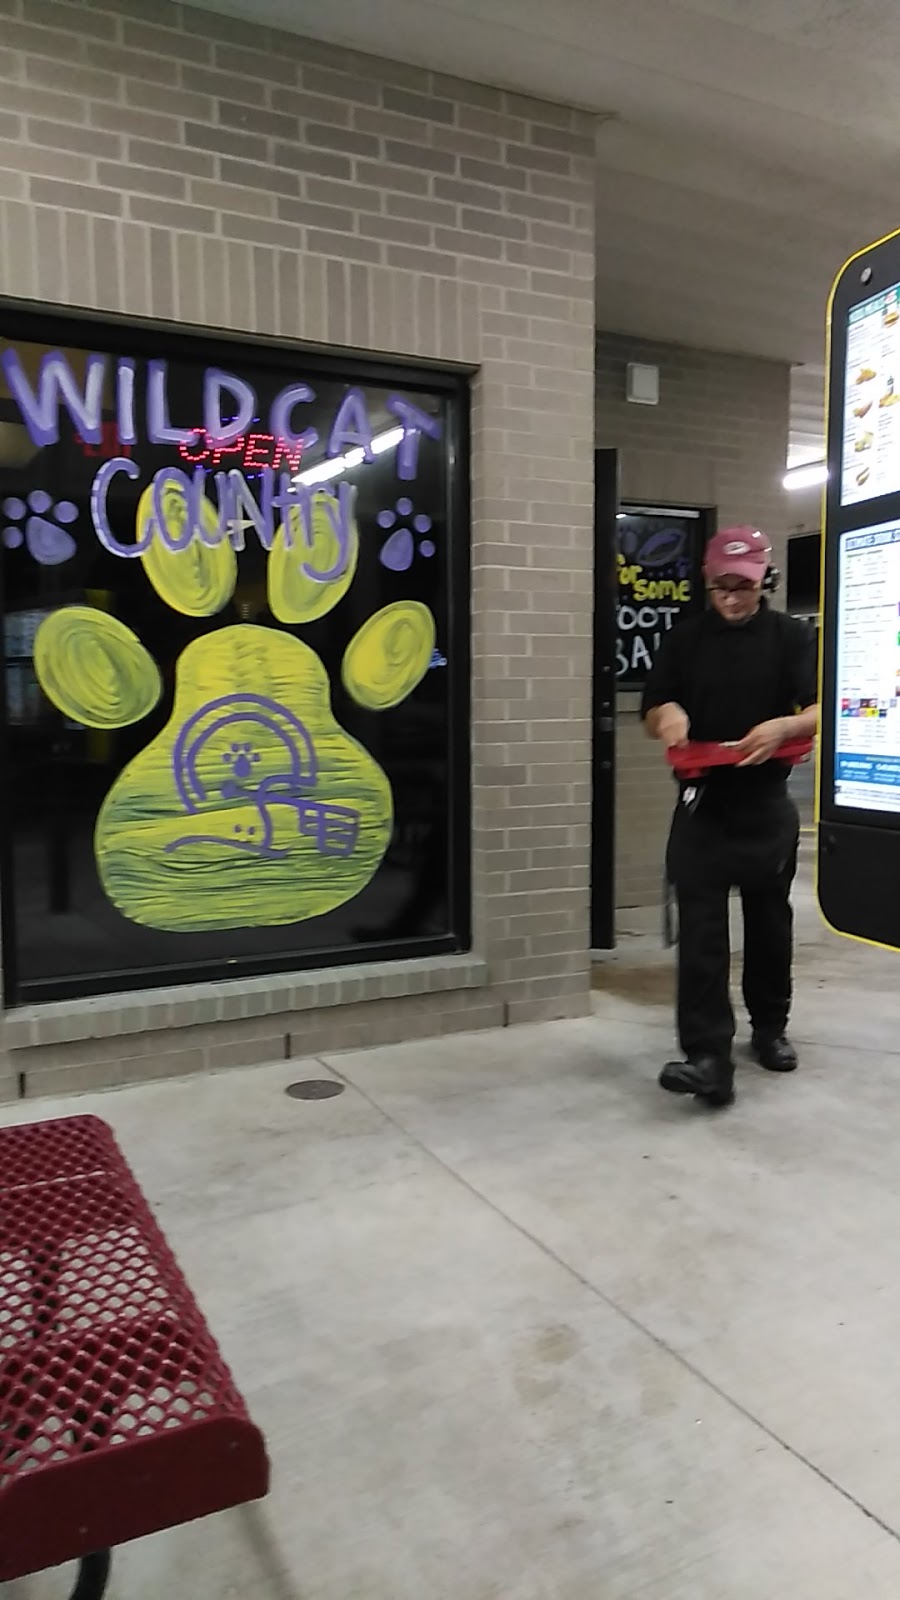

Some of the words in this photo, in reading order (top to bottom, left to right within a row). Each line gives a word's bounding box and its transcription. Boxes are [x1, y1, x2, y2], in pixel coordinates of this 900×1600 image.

[3, 347, 441, 480] WILDCAT
[178, 427, 304, 472] OPEN
[616, 604, 680, 630] OOT
